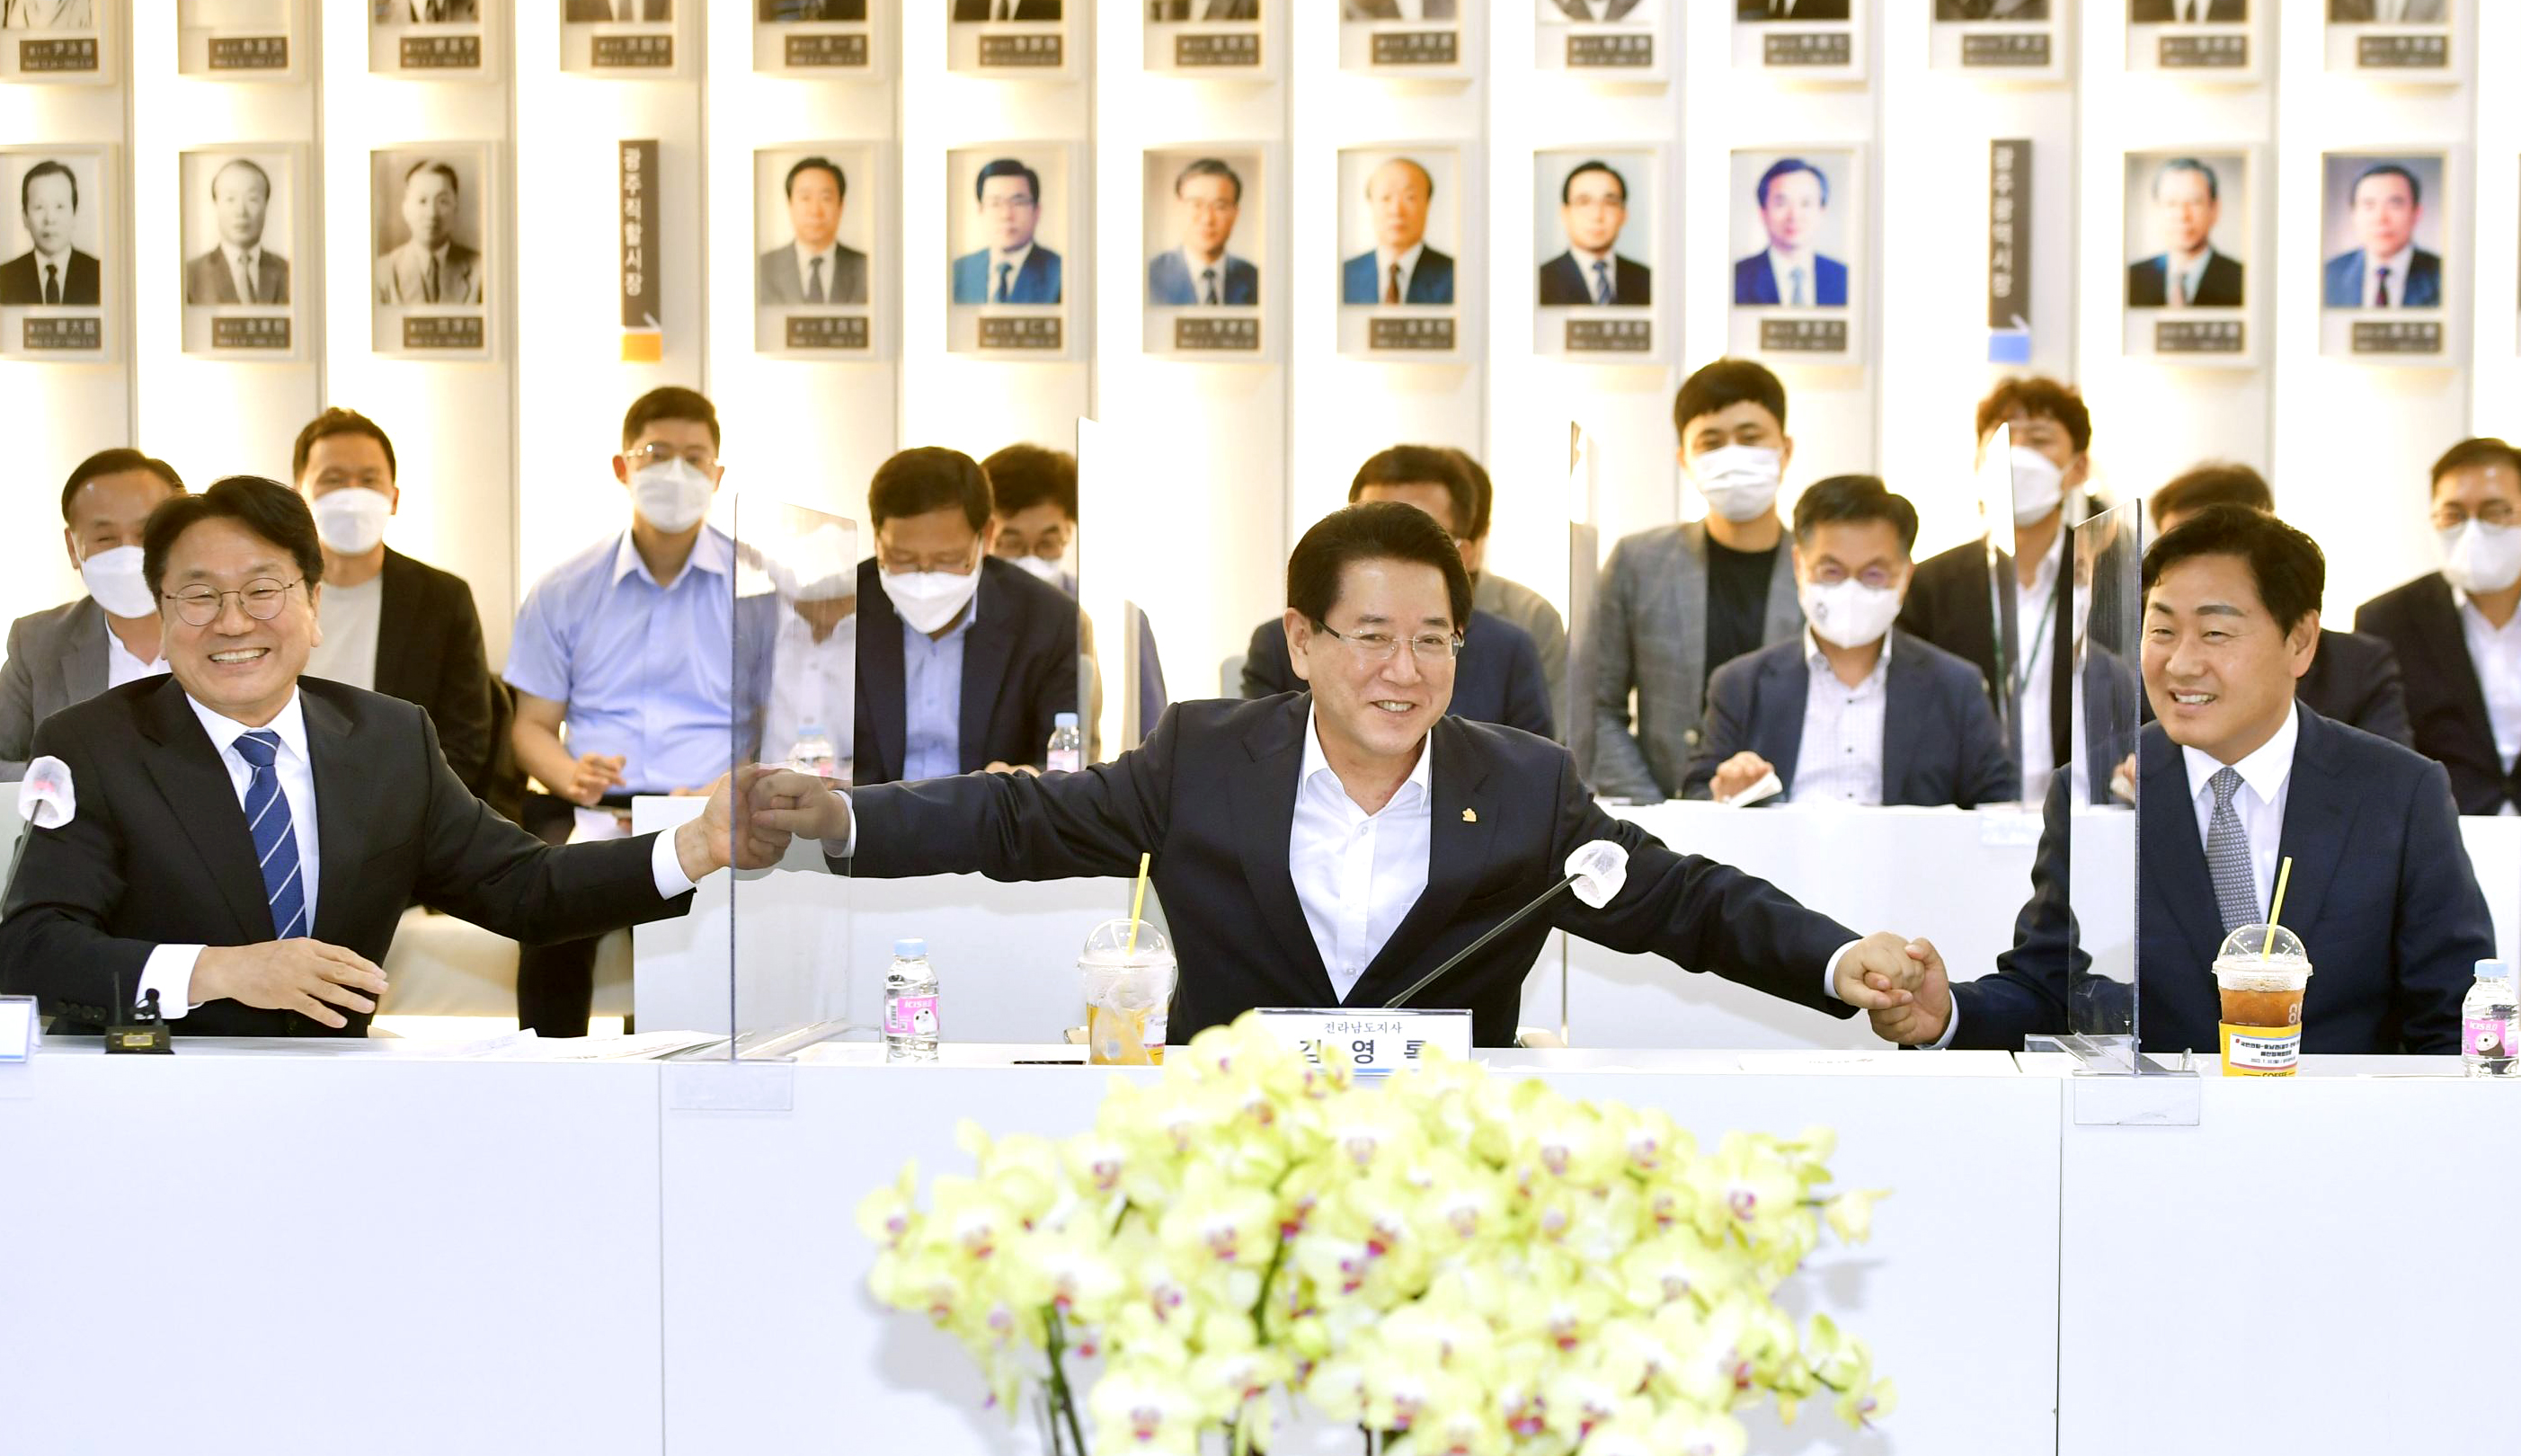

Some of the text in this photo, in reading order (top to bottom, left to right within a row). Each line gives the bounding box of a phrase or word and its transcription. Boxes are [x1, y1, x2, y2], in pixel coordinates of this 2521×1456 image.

[624, 147, 642, 296] 광주직할시장
[1992, 146, 2014, 297] 광주광역시장
[1324, 1021, 1403, 1034] 전라남도지사
